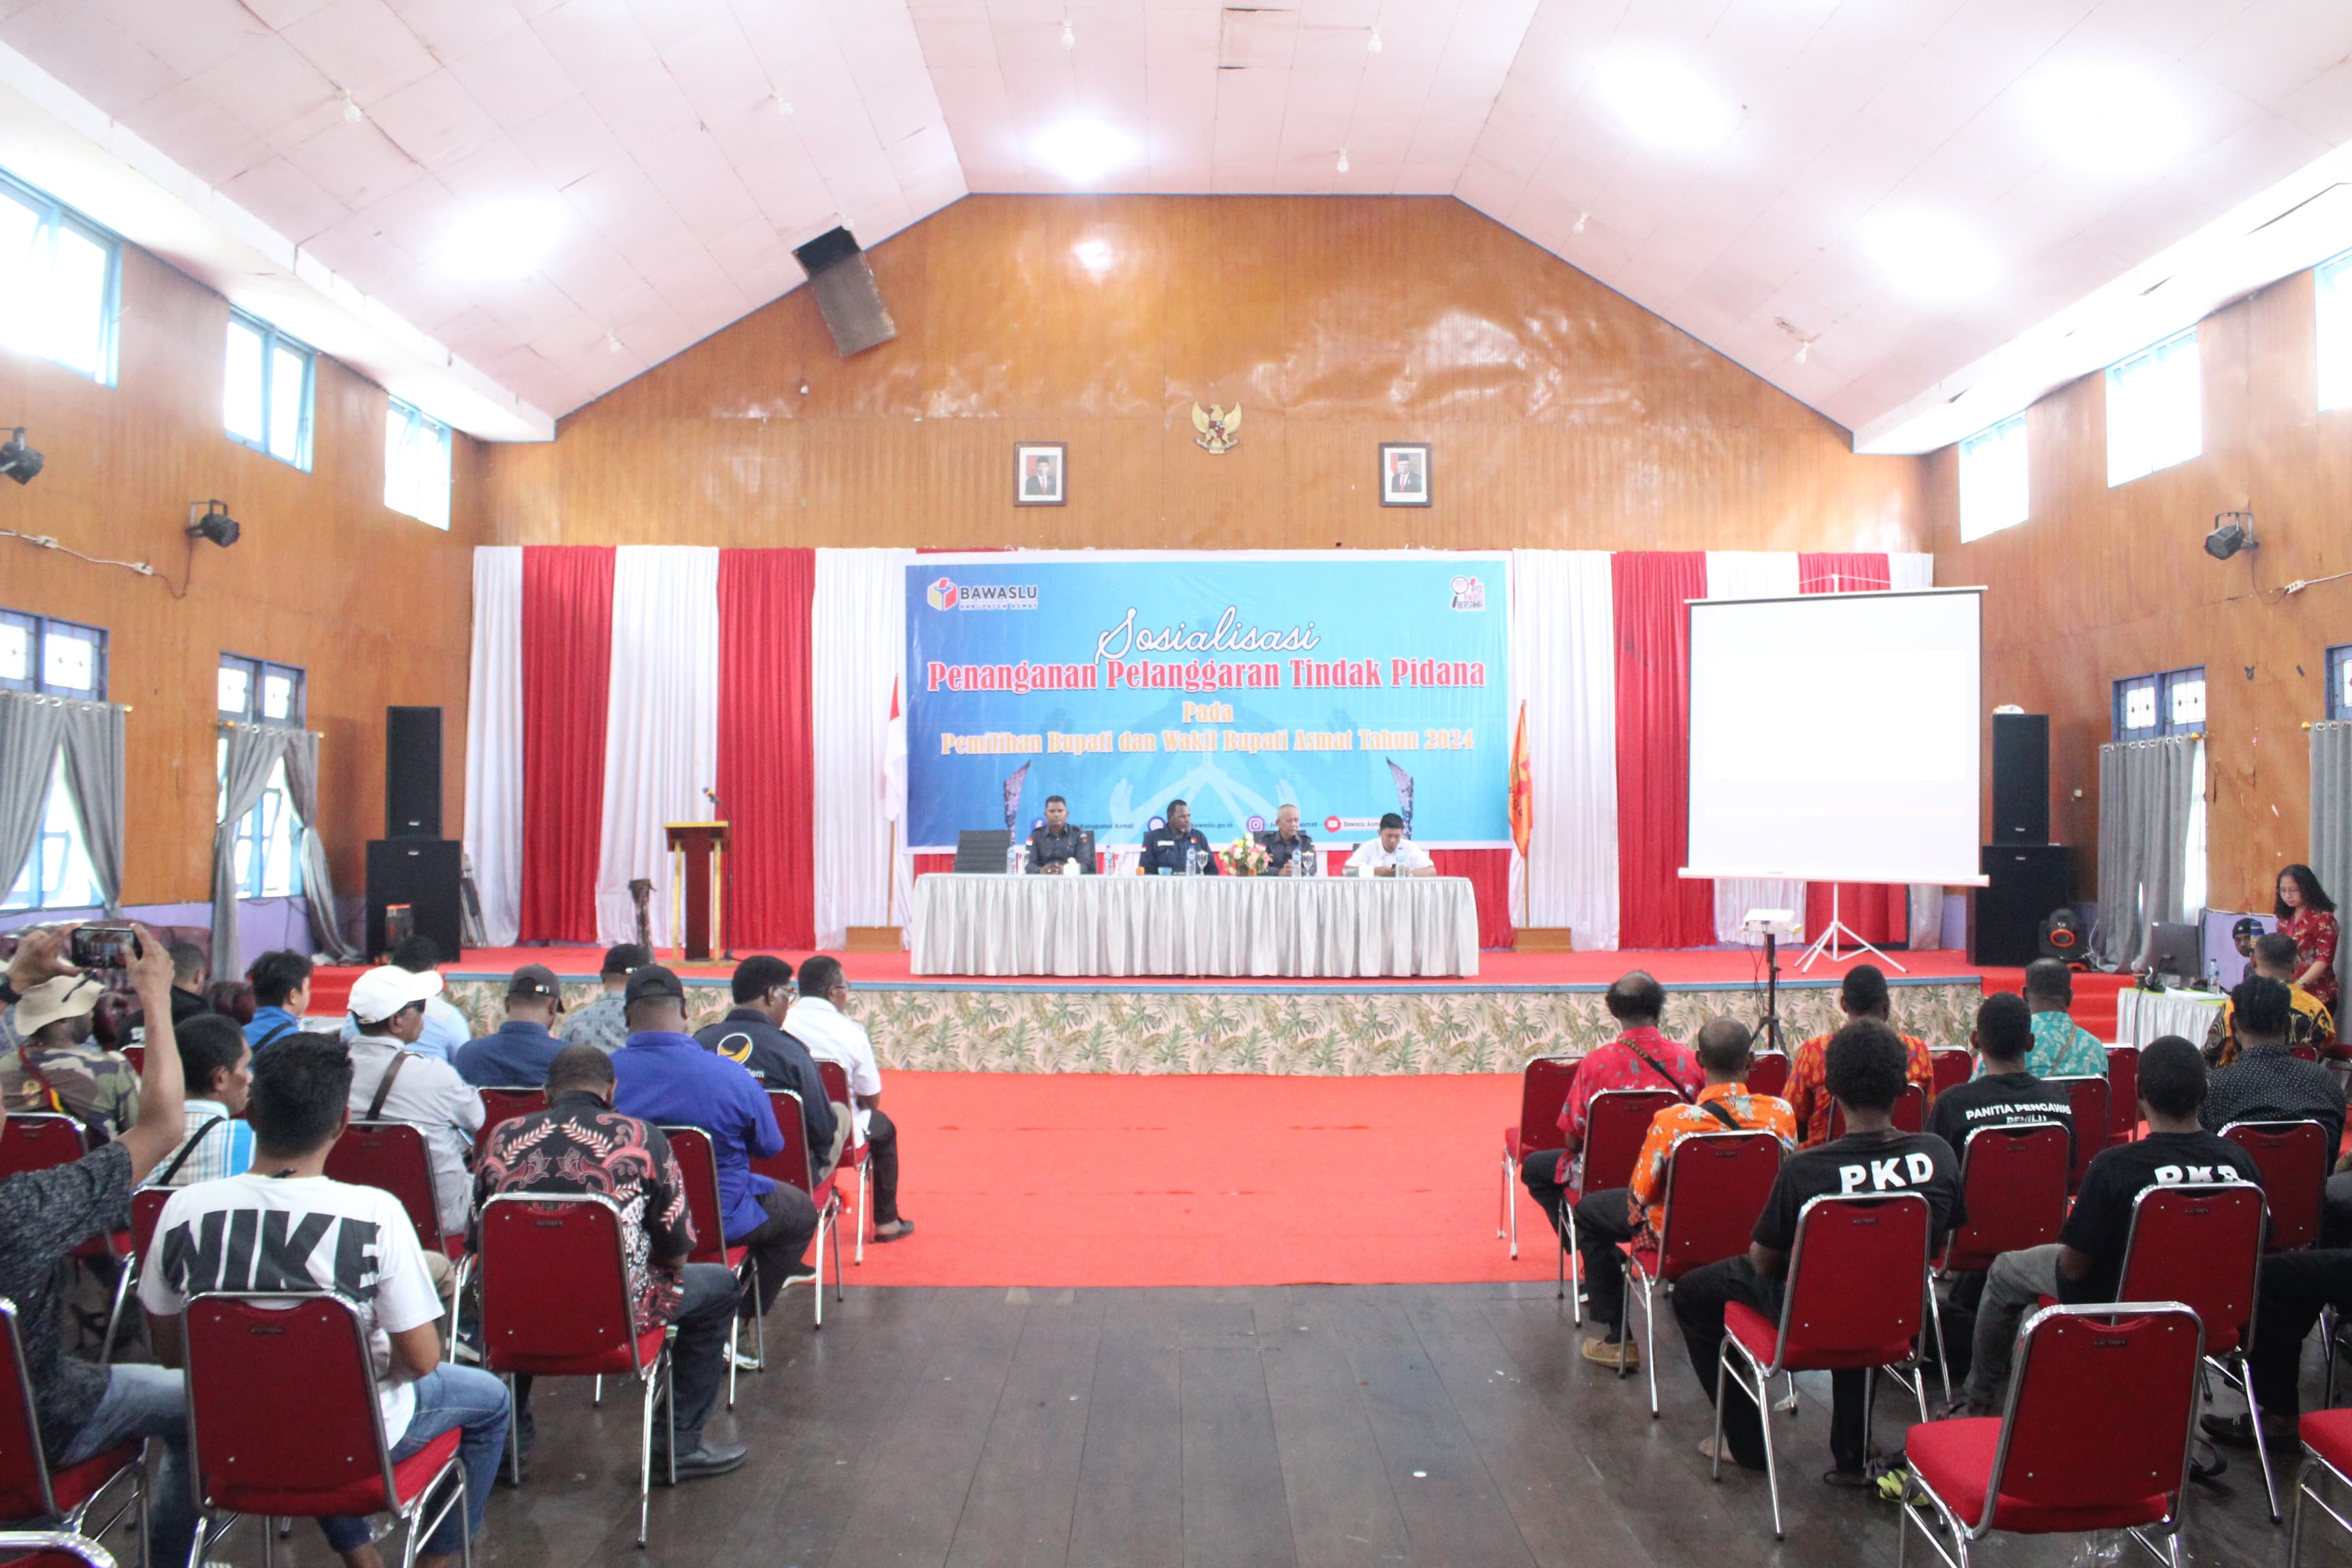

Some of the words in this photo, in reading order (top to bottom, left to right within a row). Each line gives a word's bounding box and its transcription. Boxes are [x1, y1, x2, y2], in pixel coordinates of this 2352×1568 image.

[960, 587, 1037, 600] BAWASLU
[1094, 605, 1321, 665] Sosialisasi
[928, 661, 1097, 693] Penanganan
[1107, 659, 1280, 692] Pelanggaran
[1290, 659, 1382, 688] Tindak
[1391, 658, 1486, 687] Pidana
[1182, 701, 1233, 723] Pada
[941, 732, 1043, 755] Pemilihan
[1047, 731, 1113, 756] Bupati
[1118, 730, 1156, 751] dan
[1162, 730, 1217, 752] Wakil
[1223, 730, 1288, 754] Bupati
[1294, 730, 1354, 751] Asmat
[1357, 729, 1419, 750] Tahun
[1424, 728, 1474, 750] 2024
[1965, 1104, 2014, 1120] PANITIA
[2014, 1102, 2072, 1115] PENGAWAS
[1839, 1153, 1933, 1193] PKD
[161, 1209, 381, 1302] NIKE
